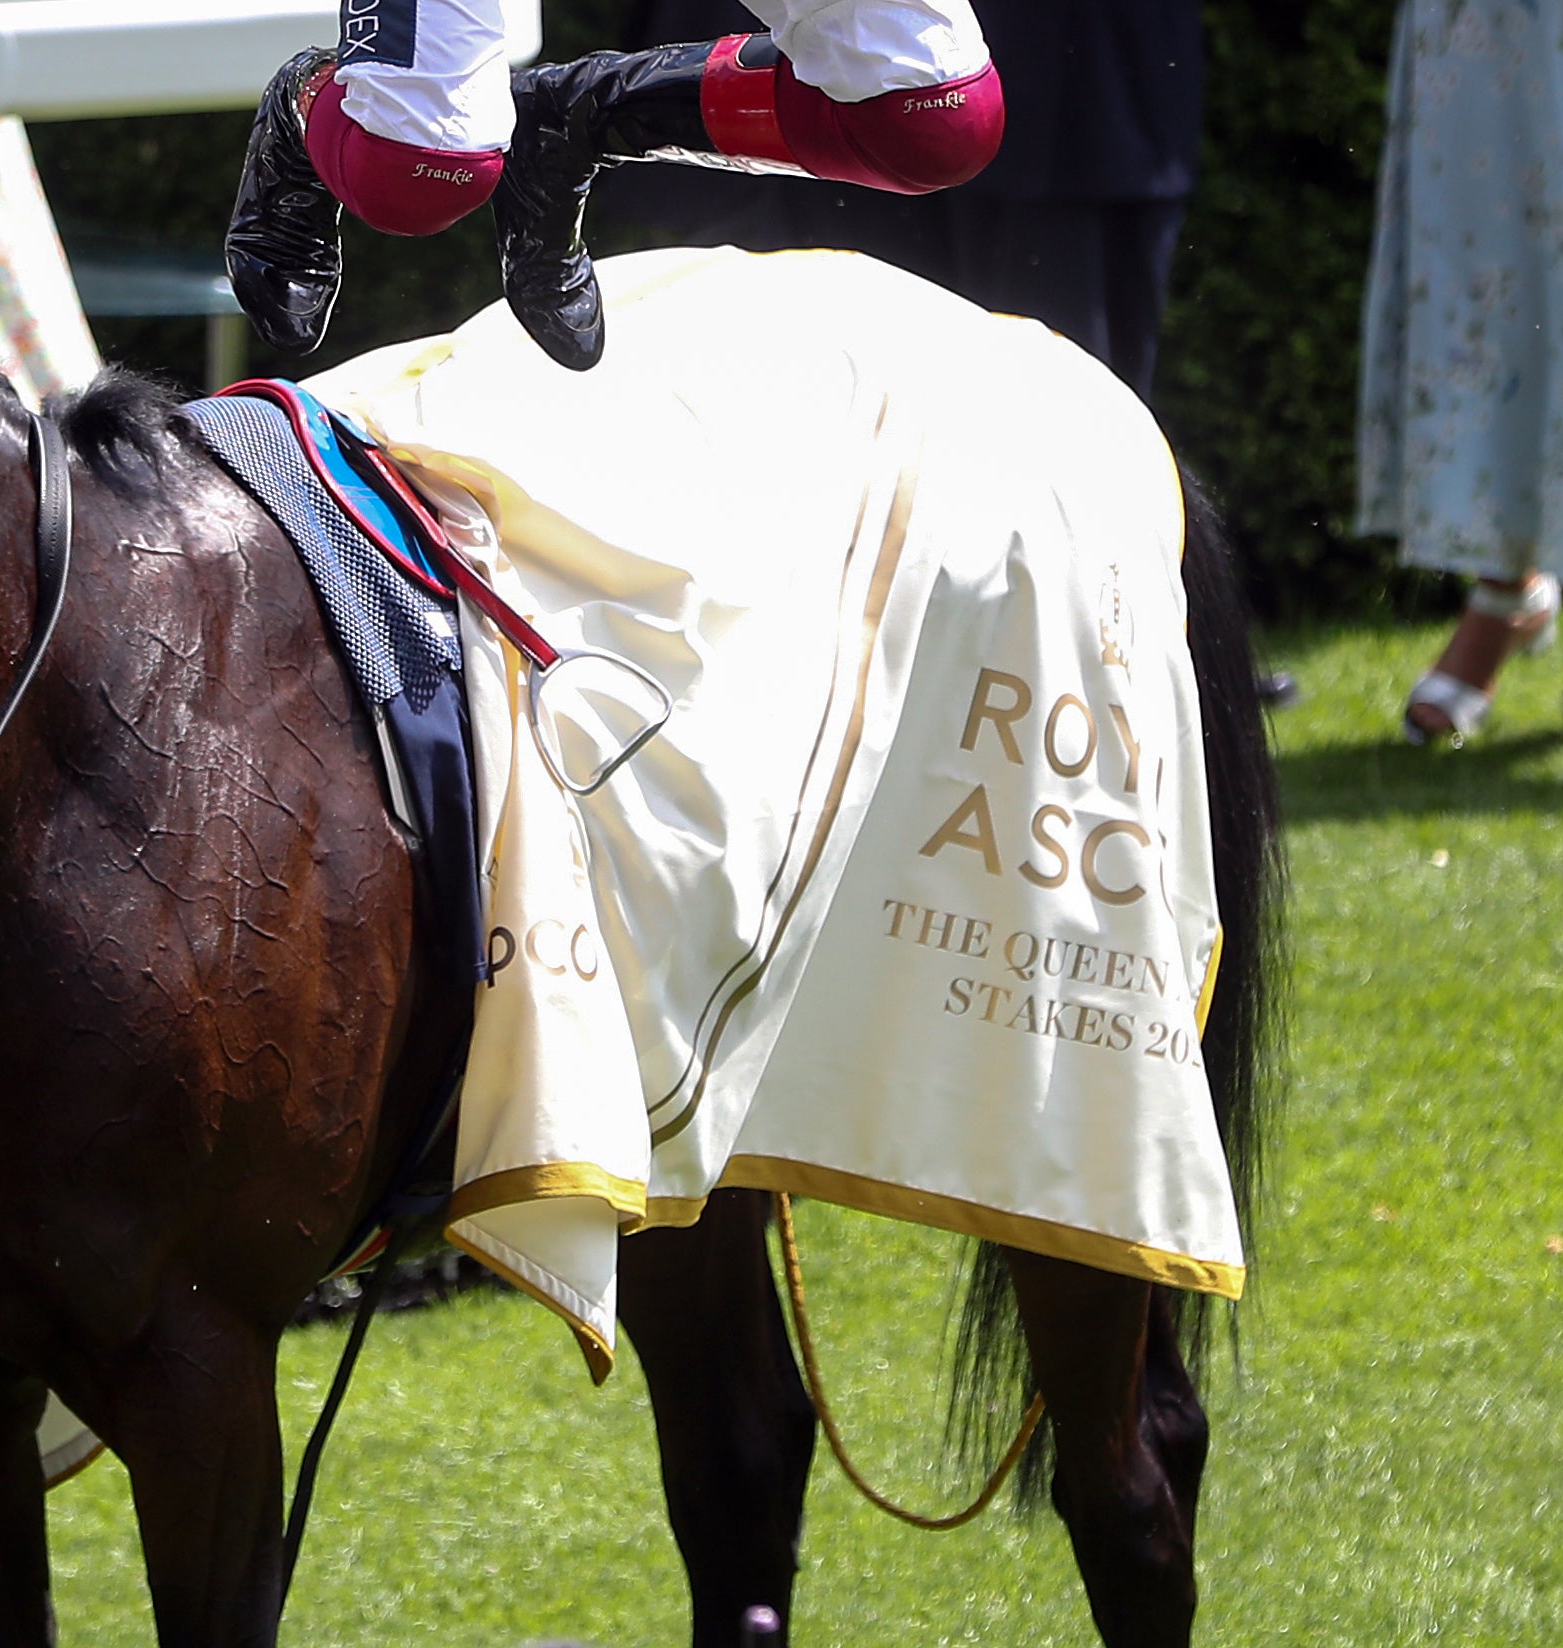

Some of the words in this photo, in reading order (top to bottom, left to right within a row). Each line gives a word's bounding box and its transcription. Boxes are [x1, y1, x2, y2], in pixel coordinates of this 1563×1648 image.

[903, 91, 966, 114] Frankie
[412, 163, 473, 185] Frankie
[959, 667, 1164, 802] ROY
[918, 784, 1167, 912] ASC
[884, 900, 993, 960] THE
[1004, 931, 1170, 999] QUEEN
[944, 978, 1136, 1052] STAKES
[1144, 1022, 1202, 1069] 20
